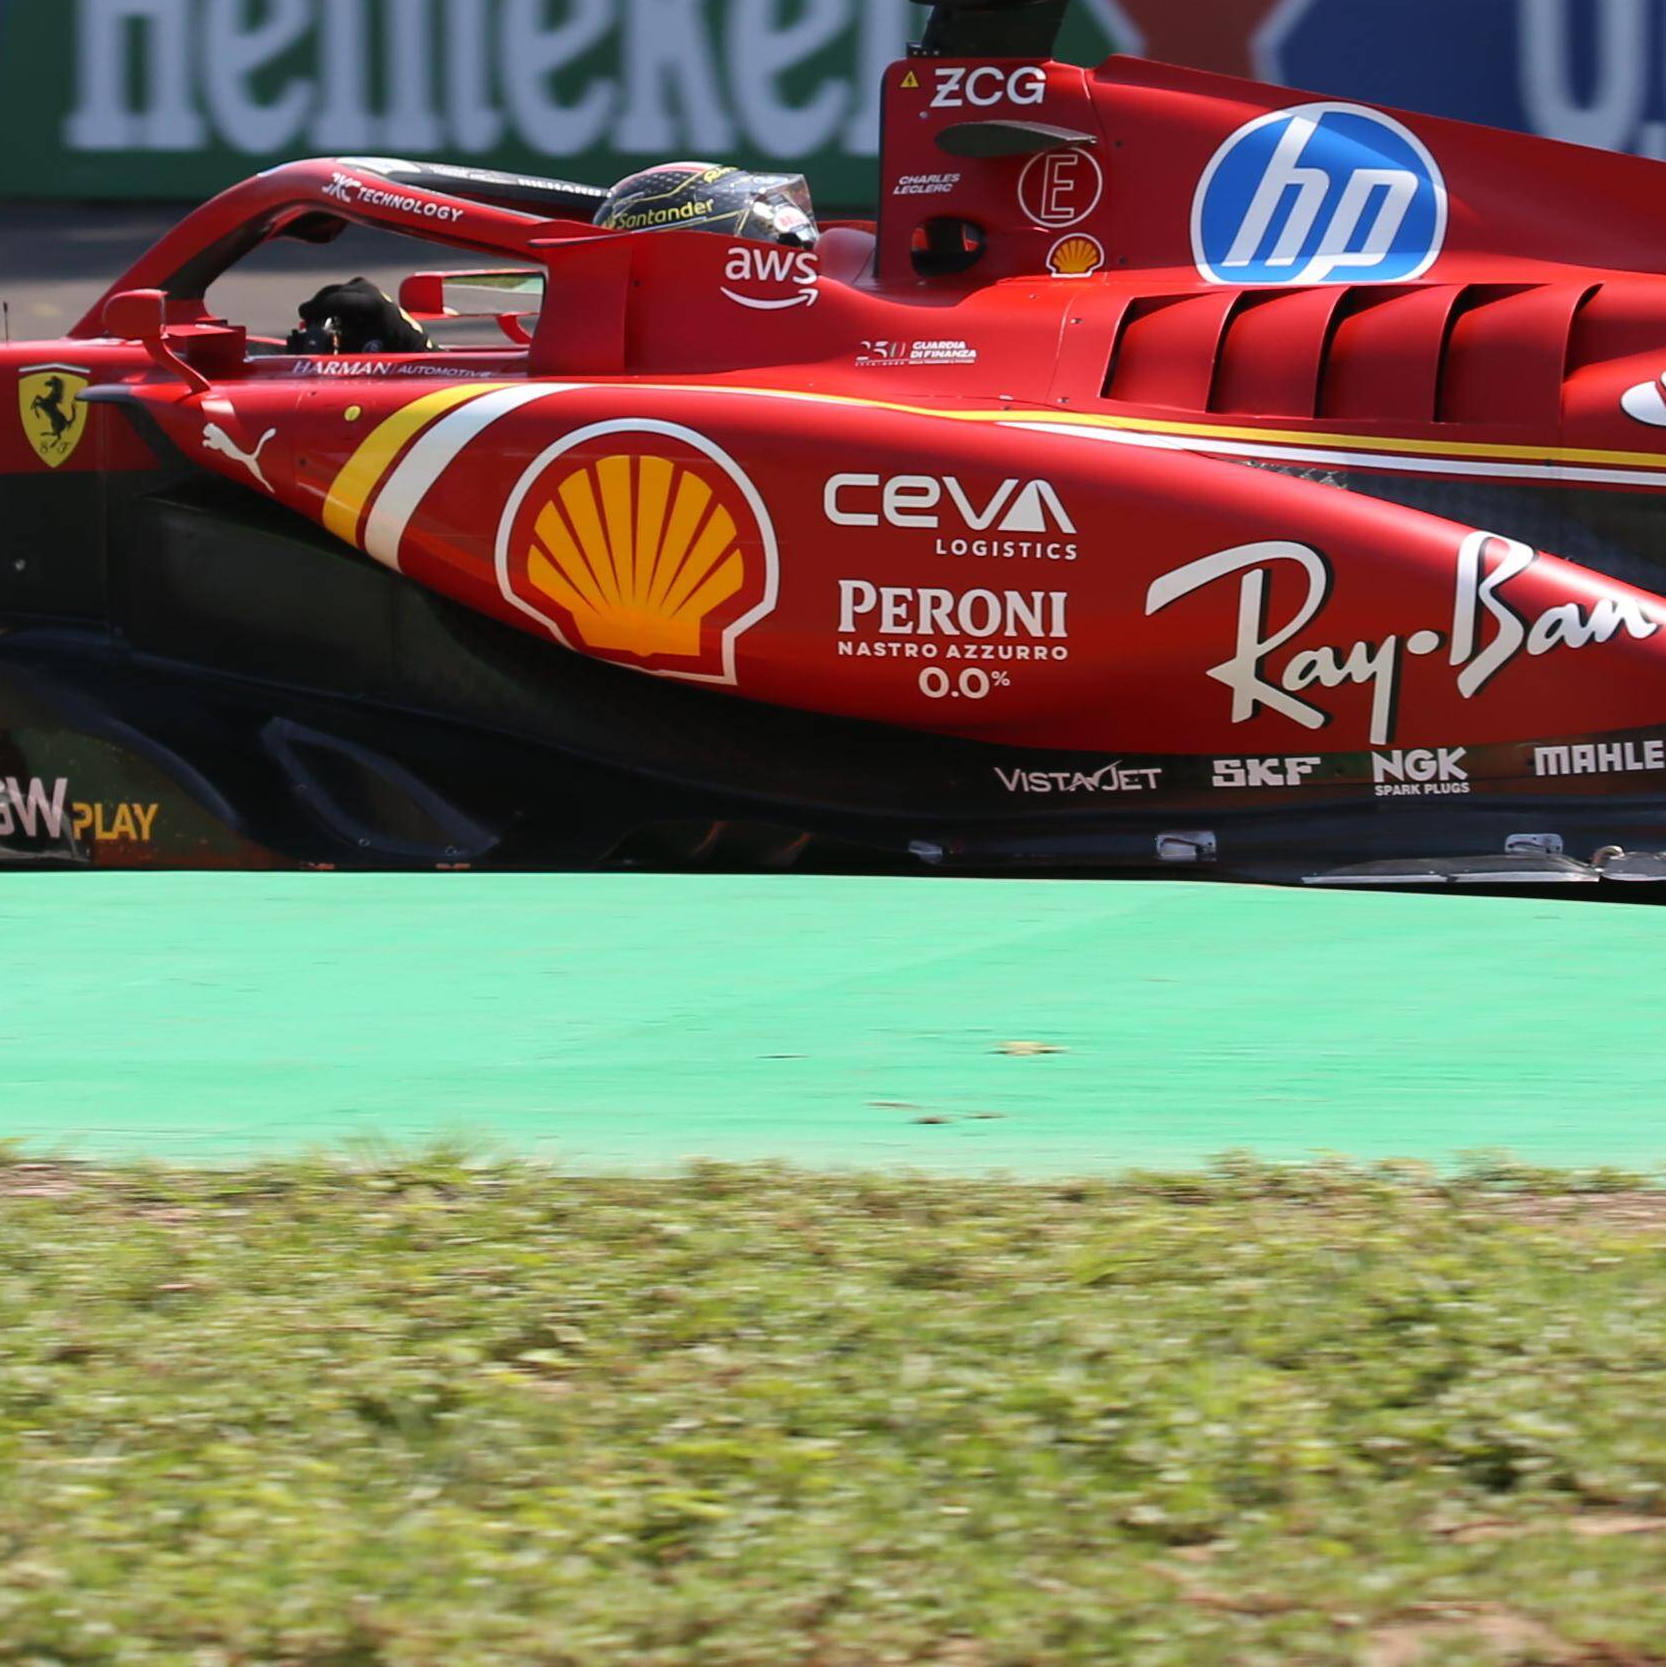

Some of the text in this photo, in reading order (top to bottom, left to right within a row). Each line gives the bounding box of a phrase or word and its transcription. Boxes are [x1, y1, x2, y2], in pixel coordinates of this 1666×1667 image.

[930, 66, 1047, 108] ZCG
[893, 184, 954, 196] LECLERC
[898, 173, 961, 186] CHARLES
[1221, 108, 1420, 282] hp
[356, 186, 465, 223] TECHNOLOGY
[617, 198, 715, 230] Santander
[724, 246, 819, 285] aws
[911, 340, 967, 350] GUARDIA
[923, 348, 978, 359] FINANZA
[291, 360, 392, 376] HARMAN
[935, 538, 1078, 561] LOGISTICS
[837, 579, 1068, 638] PERONI
[837, 640, 1070, 662] NASTRO AZZURRO
[918, 666, 1011, 700] 0.0%
[1212, 756, 1322, 788] SKF
[1372, 746, 1470, 784] NGK
[1533, 739, 1666, 777] MAHLE
[1374, 782, 1470, 796] SPARK PLUGS
[72, 803, 159, 841] PLAY
